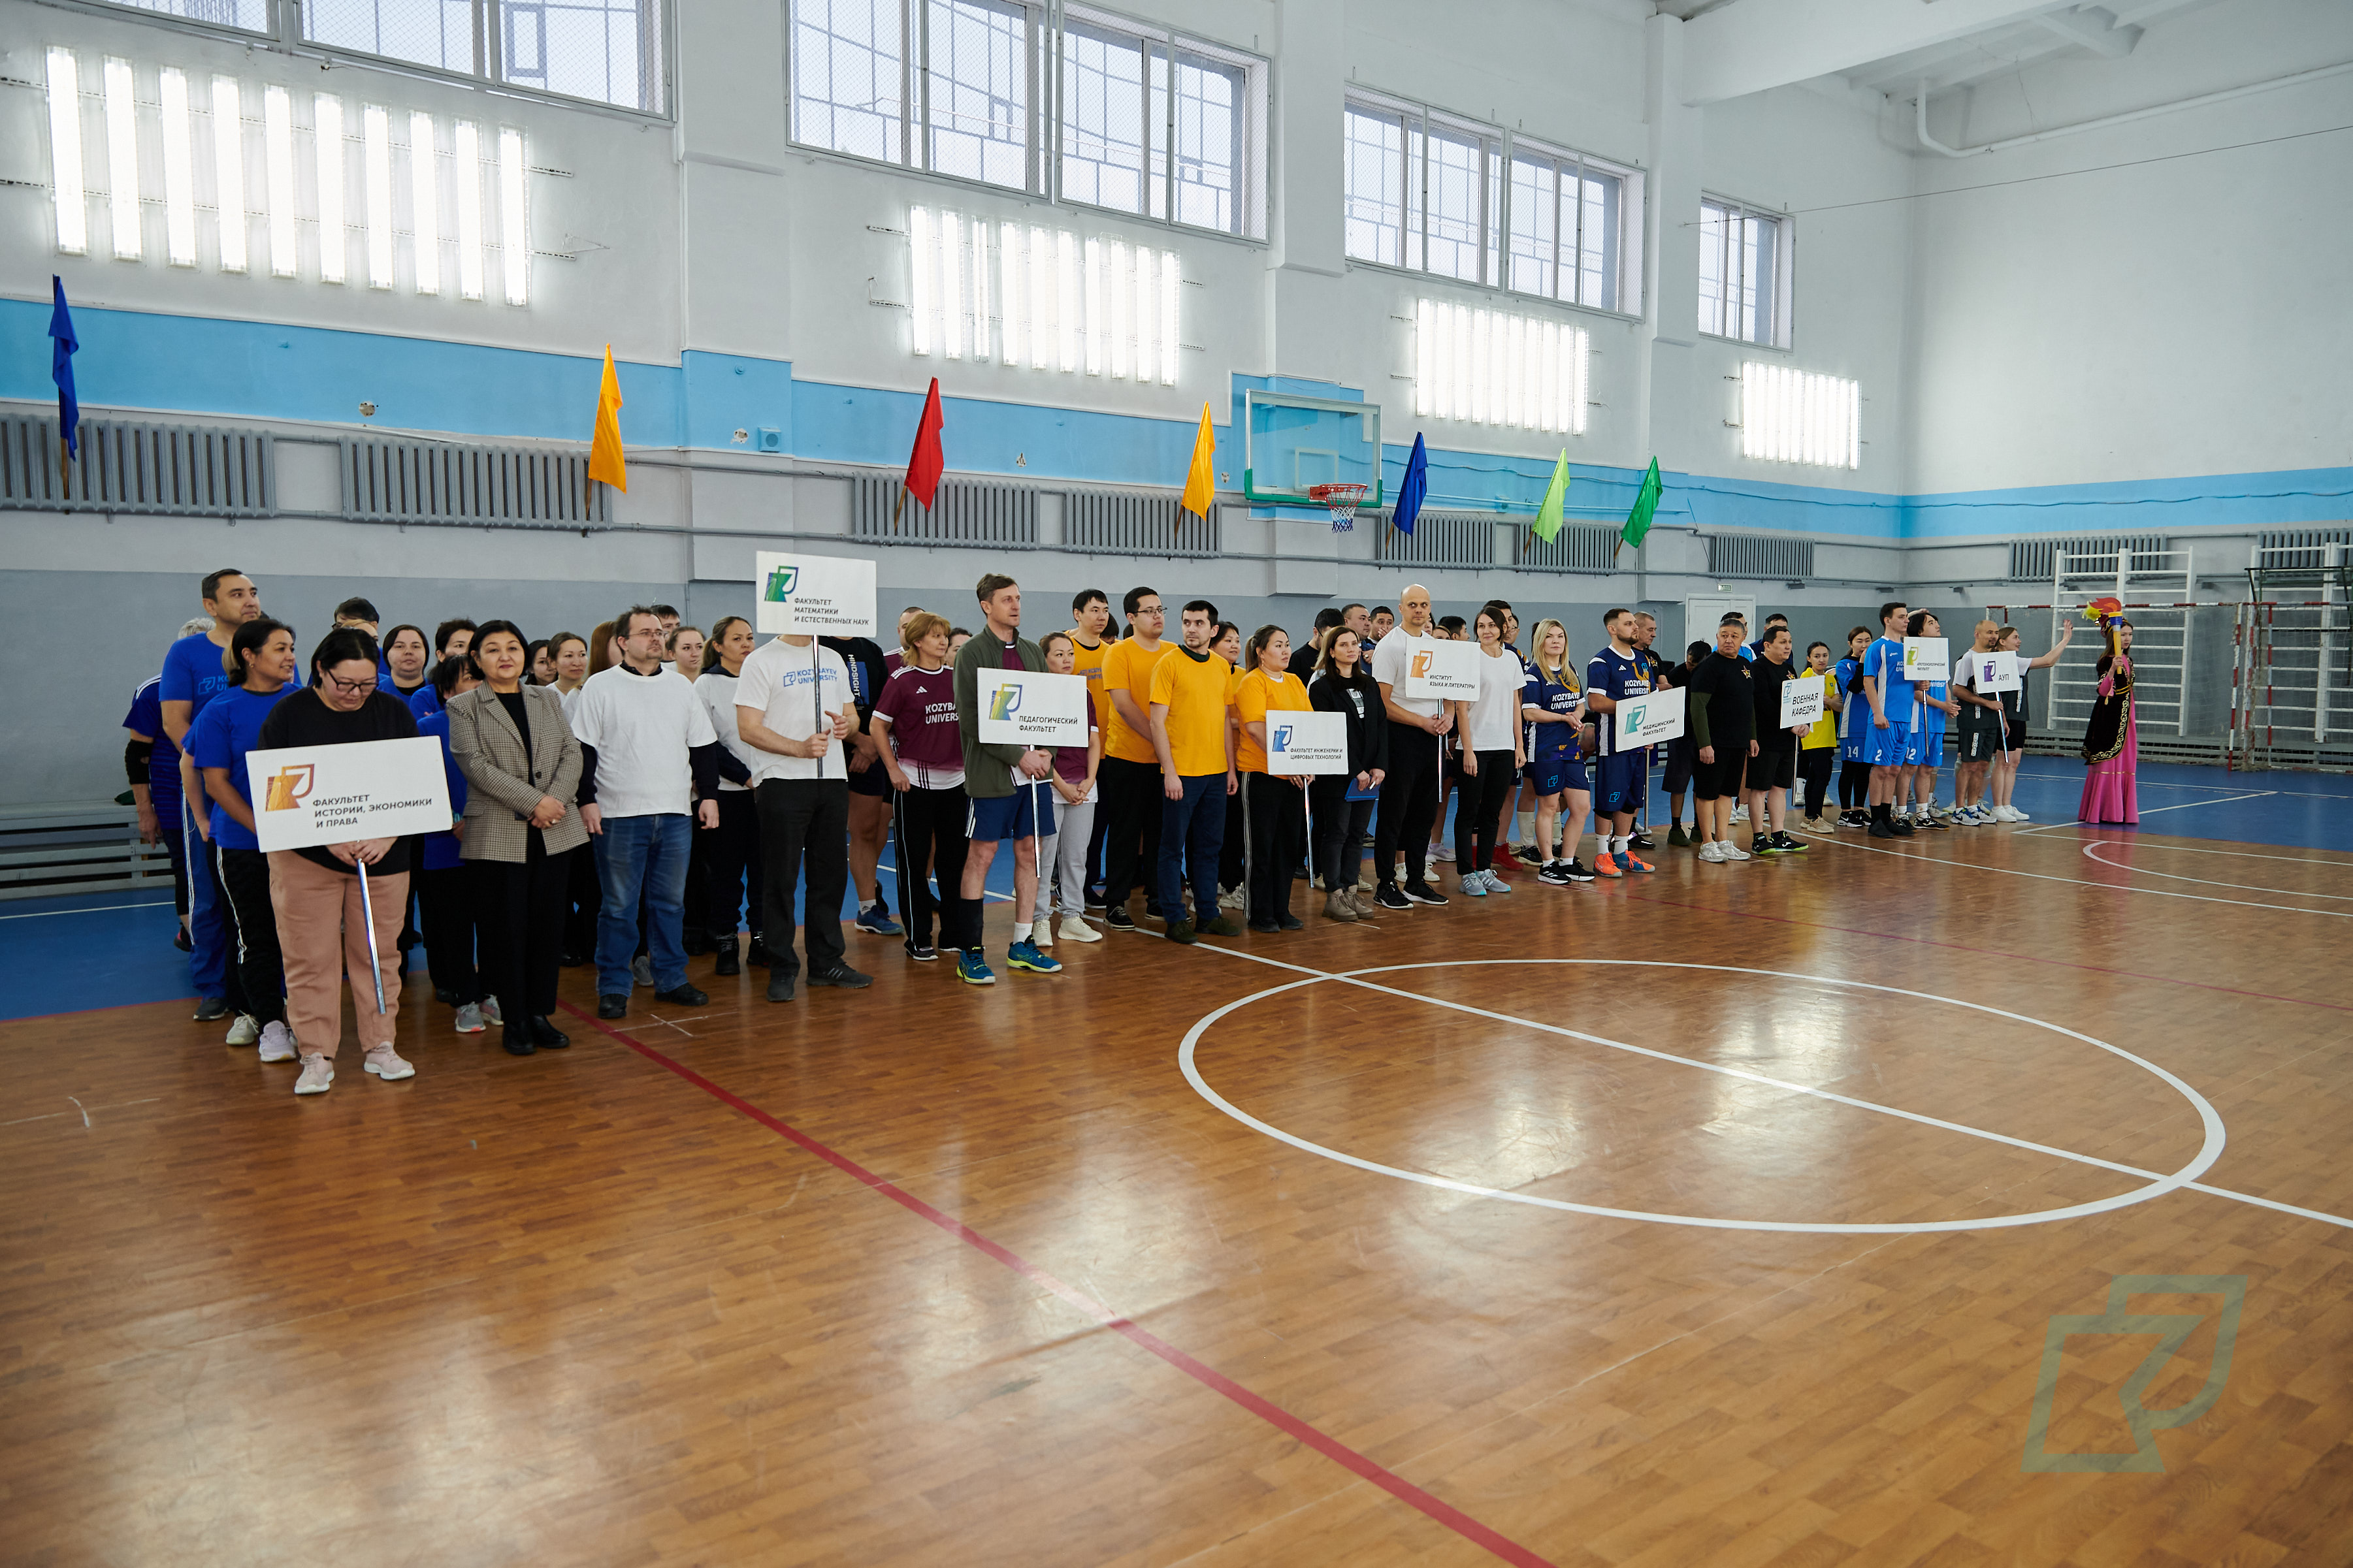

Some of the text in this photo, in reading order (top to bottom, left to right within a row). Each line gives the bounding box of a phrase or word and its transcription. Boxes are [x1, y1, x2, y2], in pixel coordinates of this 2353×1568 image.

[794, 607, 838, 615] МАТЕМАТИКИ
[801, 616, 851, 624] ЕСТЕСТВЕННЫХ
[798, 675, 837, 684] UNIVRSITY
[848, 654, 860, 697] HINDSIGHT
[1792, 692, 1819, 705] ВОЕННАЯ
[1791, 705, 1816, 717] КАФЕДРА
[1019, 716, 1078, 724] ПЕДАГОГИЧЕСКИЙ
[1642, 718, 1676, 730] МЕДИЦИНСКИЙ
[1642, 727, 1666, 737] ФАКУЛЬТЕТ
[1847, 746, 1858, 758] 14
[1874, 749, 1882, 761] 2
[1905, 746, 1917, 760] 12
[313, 794, 370, 807] ФАКУЛЬТЕТ
[315, 798, 432, 818] ИСТОРИИ, ЭКОНОМИКИ
[326, 817, 359, 827] ПРАВА
